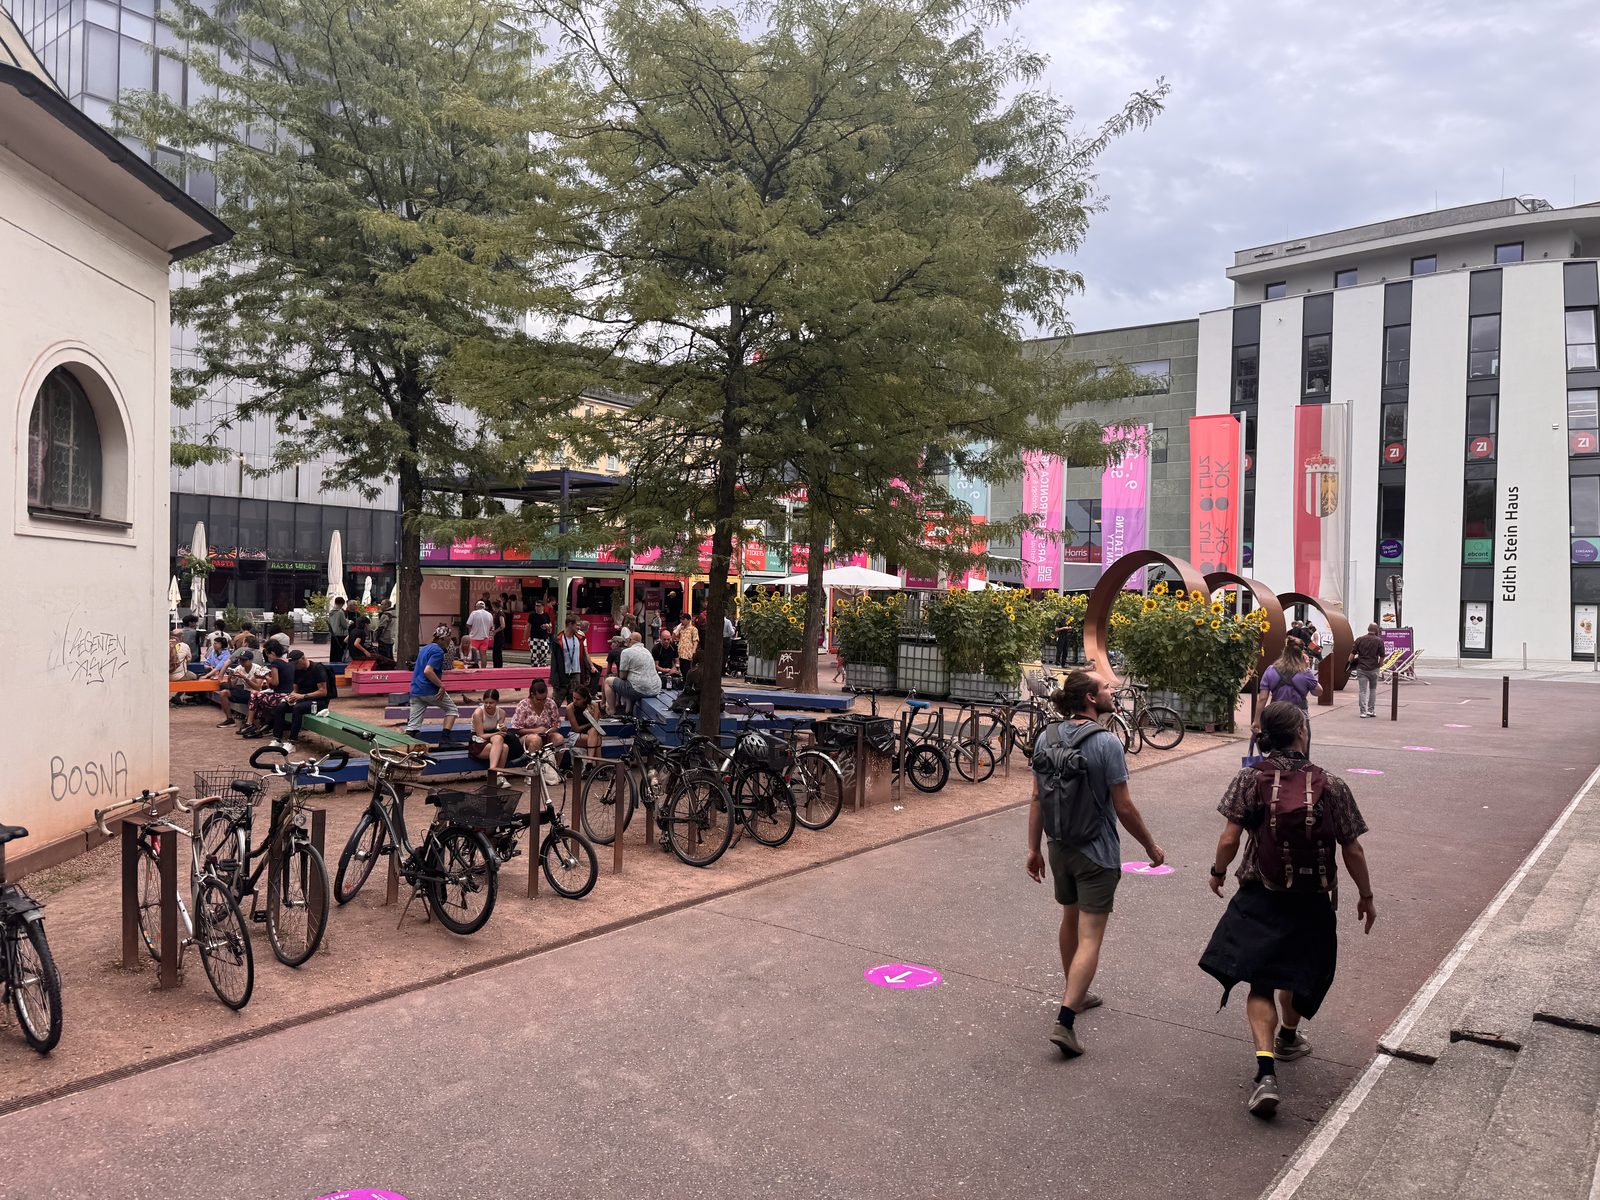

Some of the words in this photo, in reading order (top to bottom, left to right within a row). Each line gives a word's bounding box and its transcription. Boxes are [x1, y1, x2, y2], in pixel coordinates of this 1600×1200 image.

[1505, 486, 1519, 521] Haus
[1504, 525, 1518, 561] Stein
[1502, 565, 1516, 602] Edith
[49, 749, 129, 802] BOSNA
